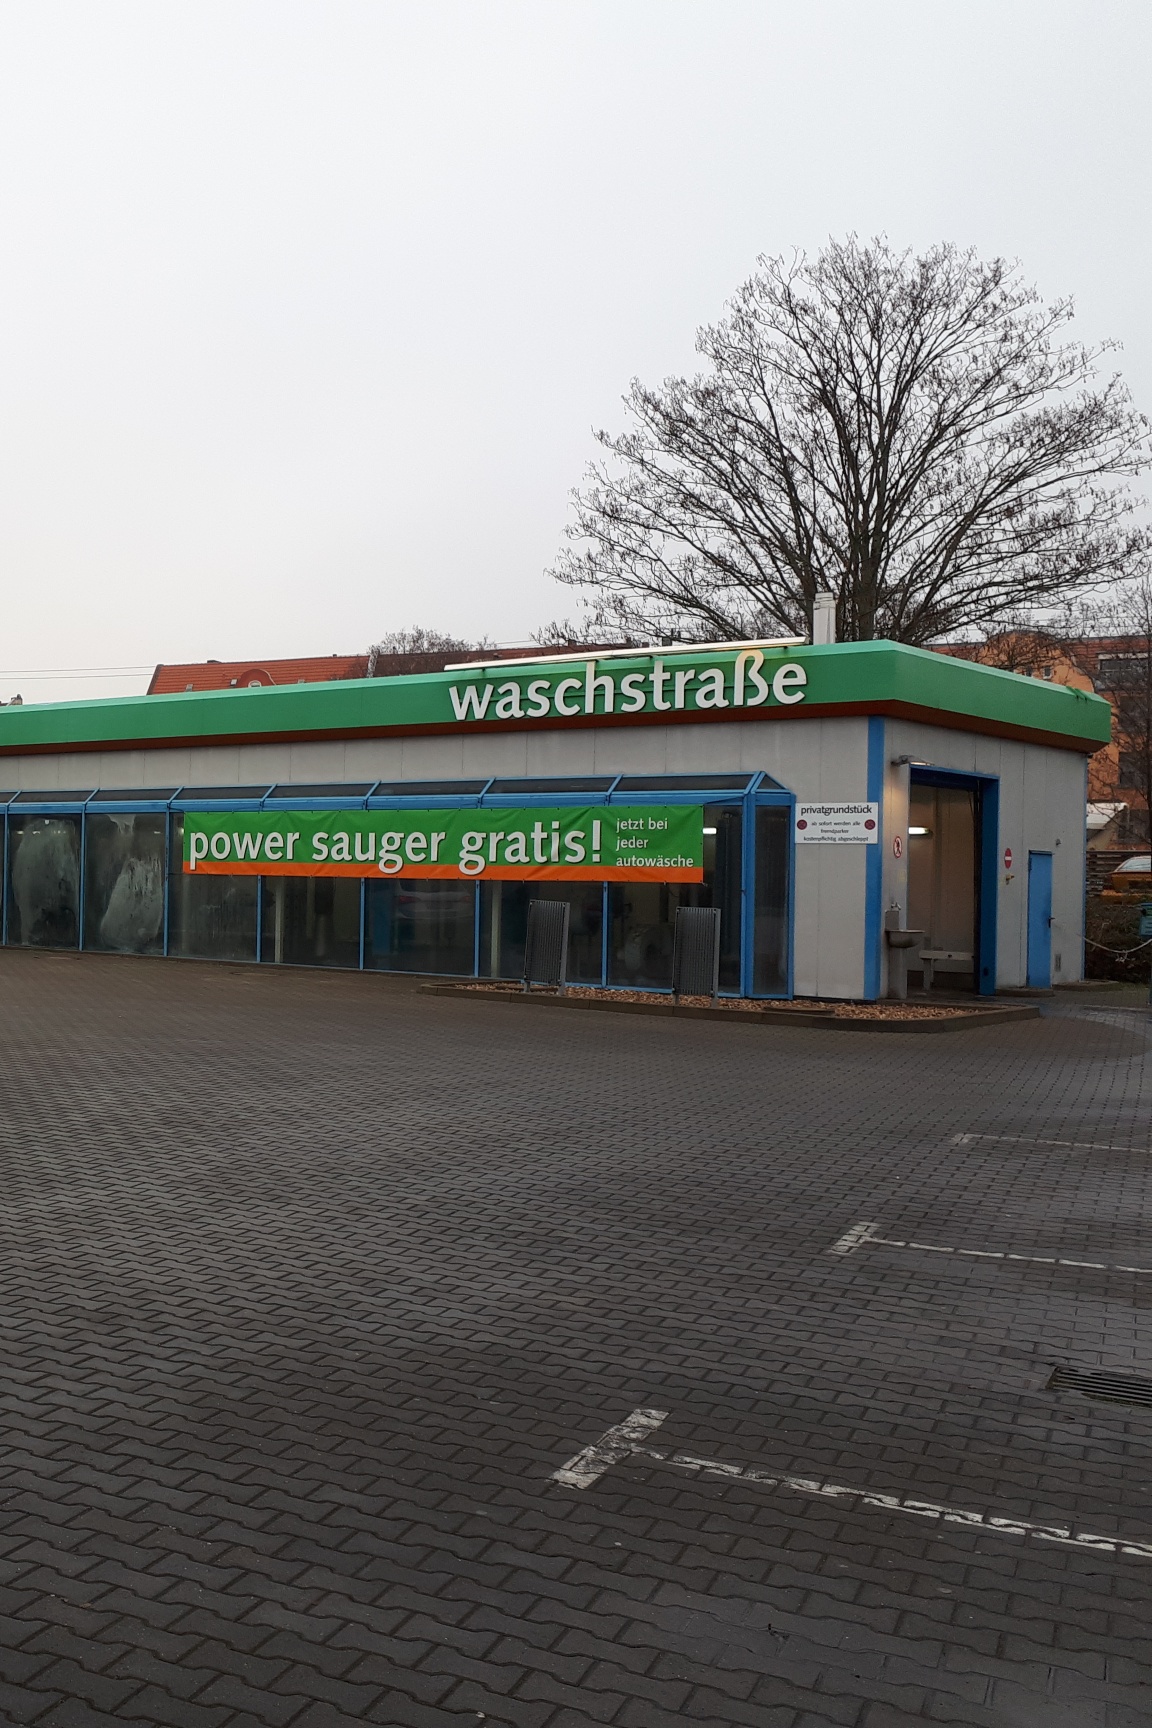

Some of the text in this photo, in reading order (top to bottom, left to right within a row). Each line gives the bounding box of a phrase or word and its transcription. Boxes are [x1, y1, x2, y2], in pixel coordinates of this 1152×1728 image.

[448, 649, 808, 721] waschstraße
[800, 804, 873, 817] privatgrundstück
[615, 816, 668, 833] jetzt bei
[189, 819, 602, 876] power sauger gratis!
[615, 835, 649, 852] jeder
[615, 854, 694, 868] autowäsche
